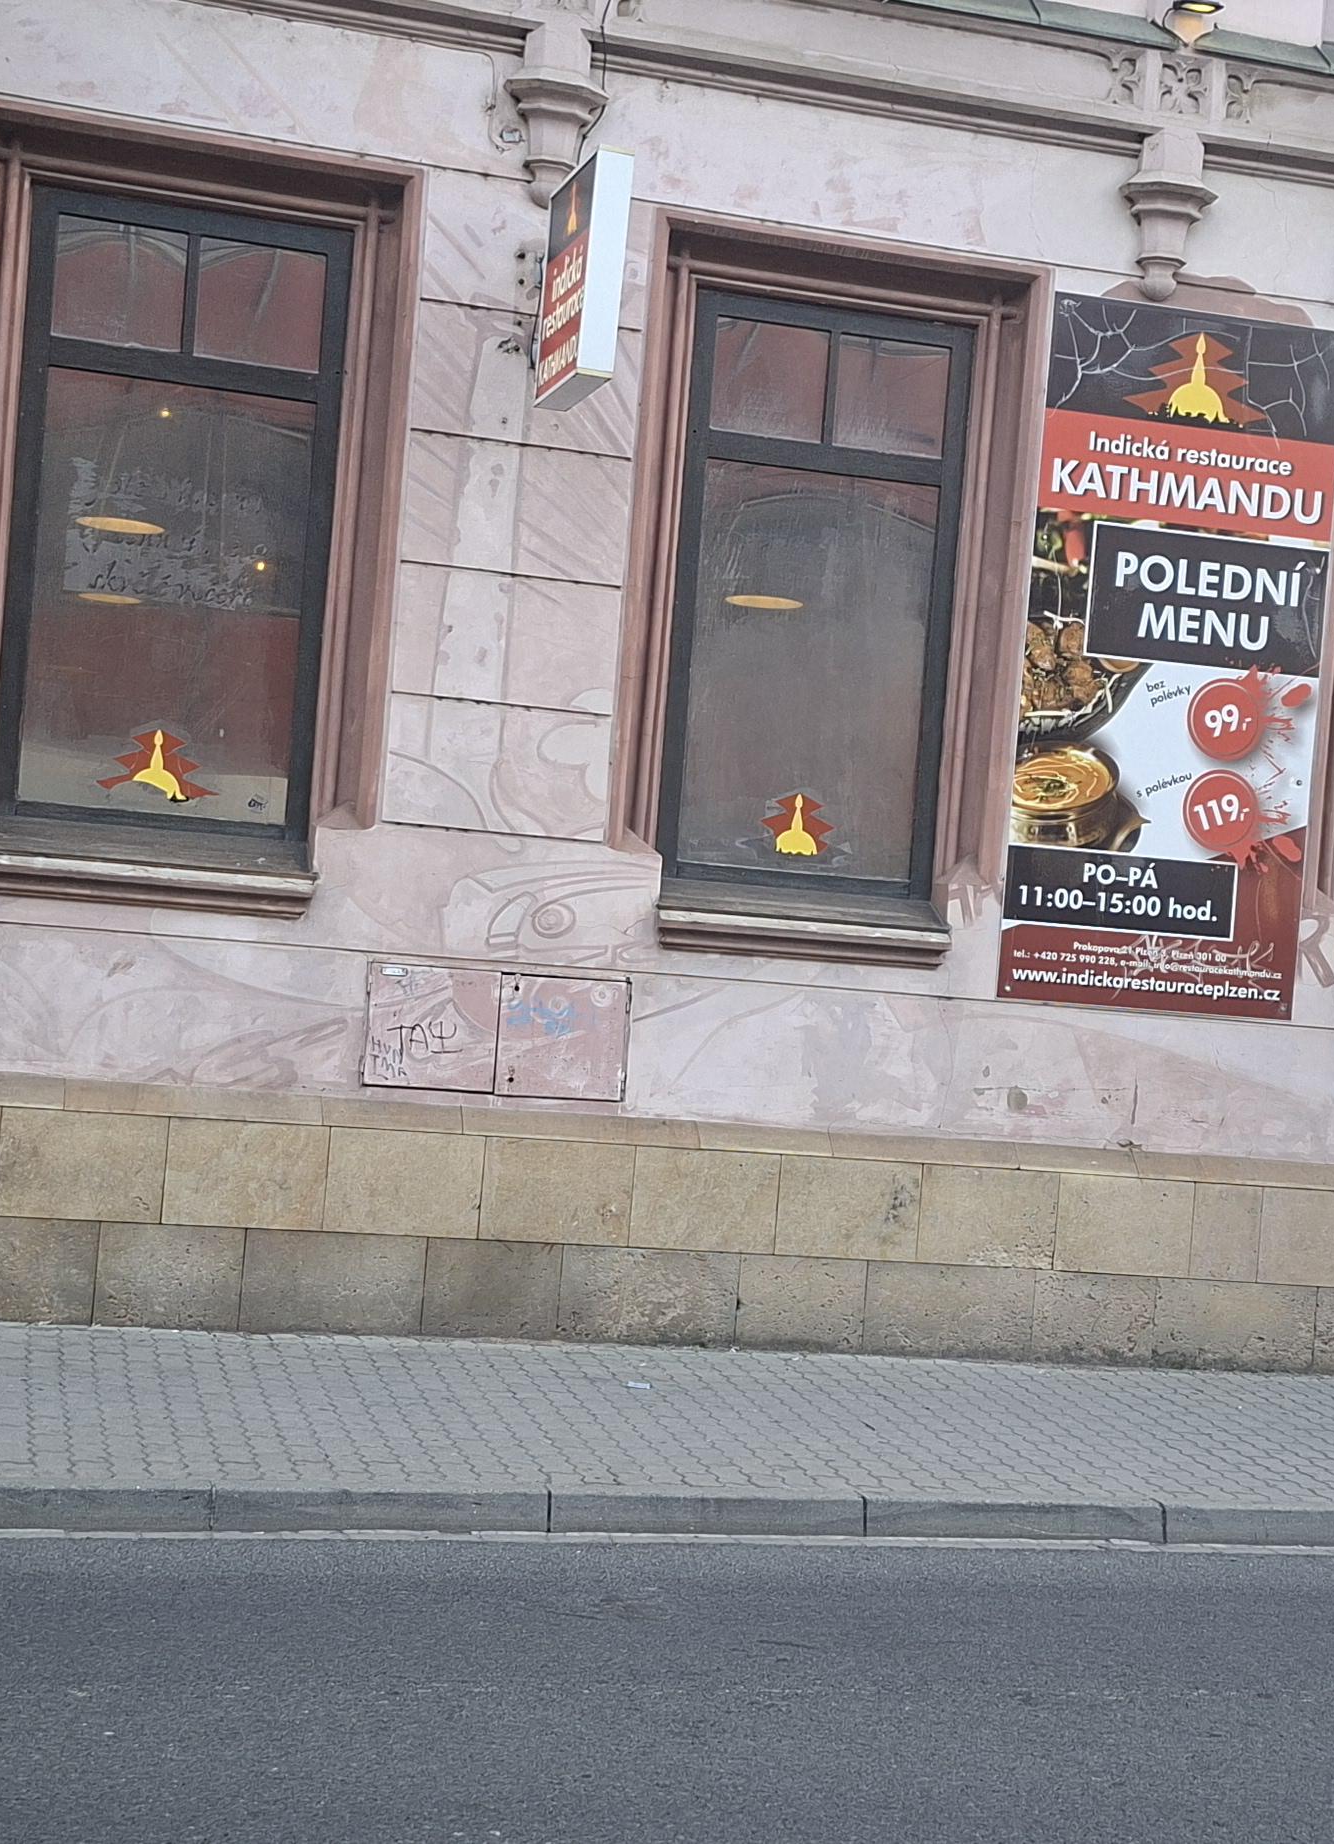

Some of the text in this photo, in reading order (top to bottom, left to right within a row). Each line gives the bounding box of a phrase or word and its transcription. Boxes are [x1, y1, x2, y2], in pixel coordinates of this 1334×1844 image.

[1088, 430, 1293, 477] Indická restaurace
[1050, 457, 1324, 526] KATHMANDU
[1114, 550, 1307, 608] POLEDNÍ
[1137, 602, 1270, 652] MENU
[1145, 680, 1167, 693] bez
[1150, 685, 1192, 708] polévky
[1145, 772, 1193, 797] polévkou
[1168, 896, 1218, 922] hod.
[1033, 951, 1058, 961] +420
[1060, 952, 1077, 962] 725
[1079, 954, 1096, 964] 990
[1012, 967, 1281, 1001] www.indickarestauraceplzen.cz
